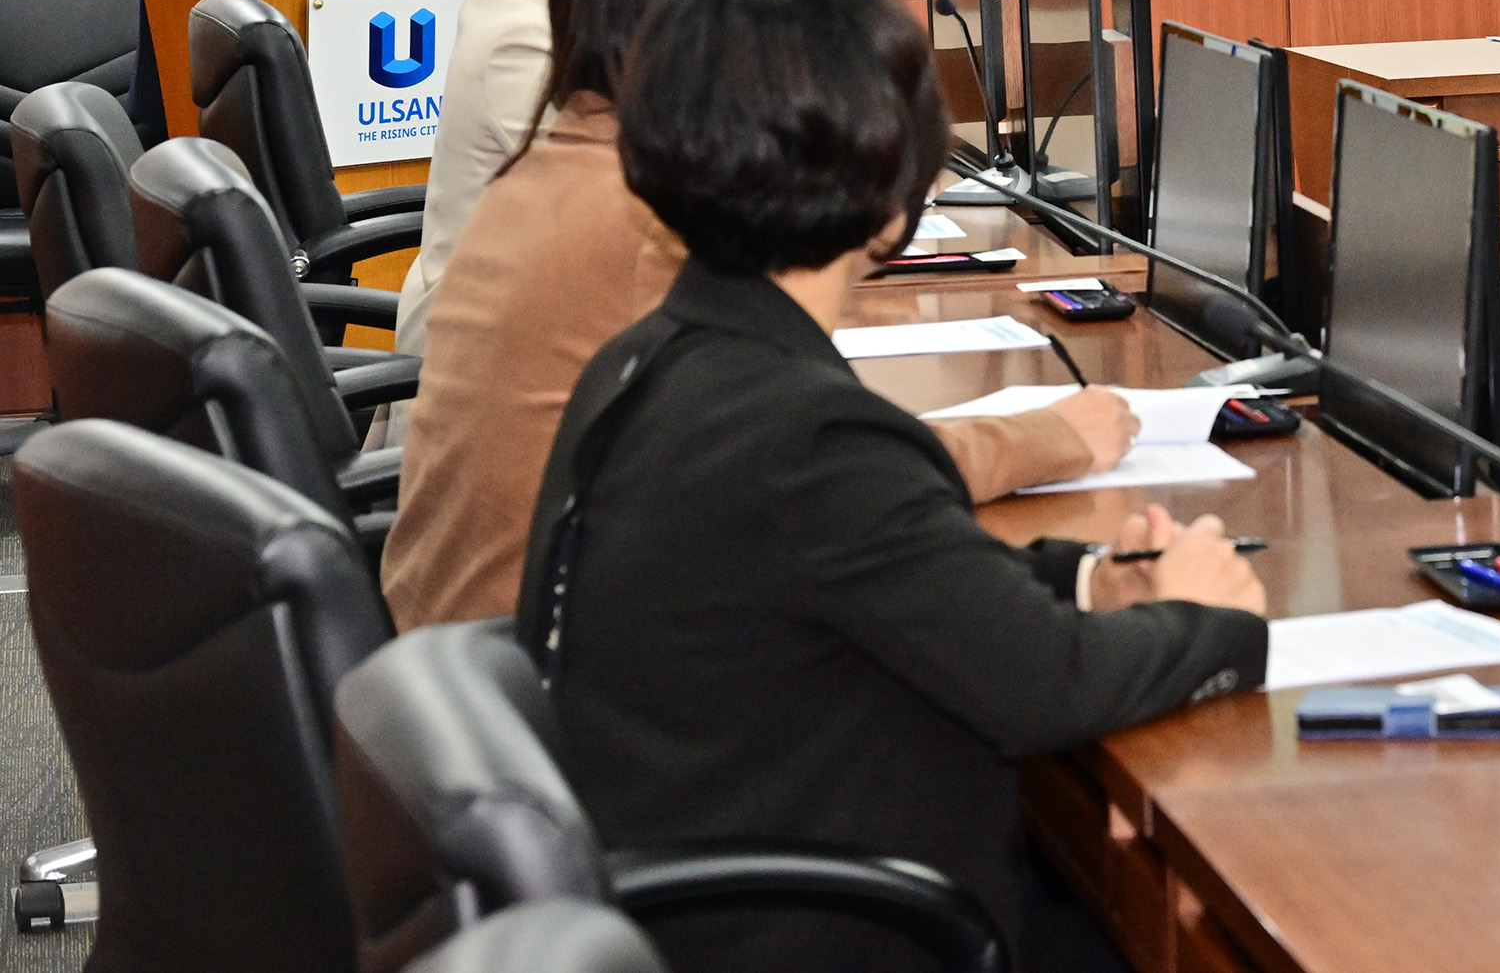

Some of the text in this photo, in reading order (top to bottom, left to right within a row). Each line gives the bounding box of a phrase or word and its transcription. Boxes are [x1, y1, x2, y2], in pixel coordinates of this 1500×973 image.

[358, 95, 443, 126] ULSAN
[358, 125, 437, 142] THE RISING CIT
